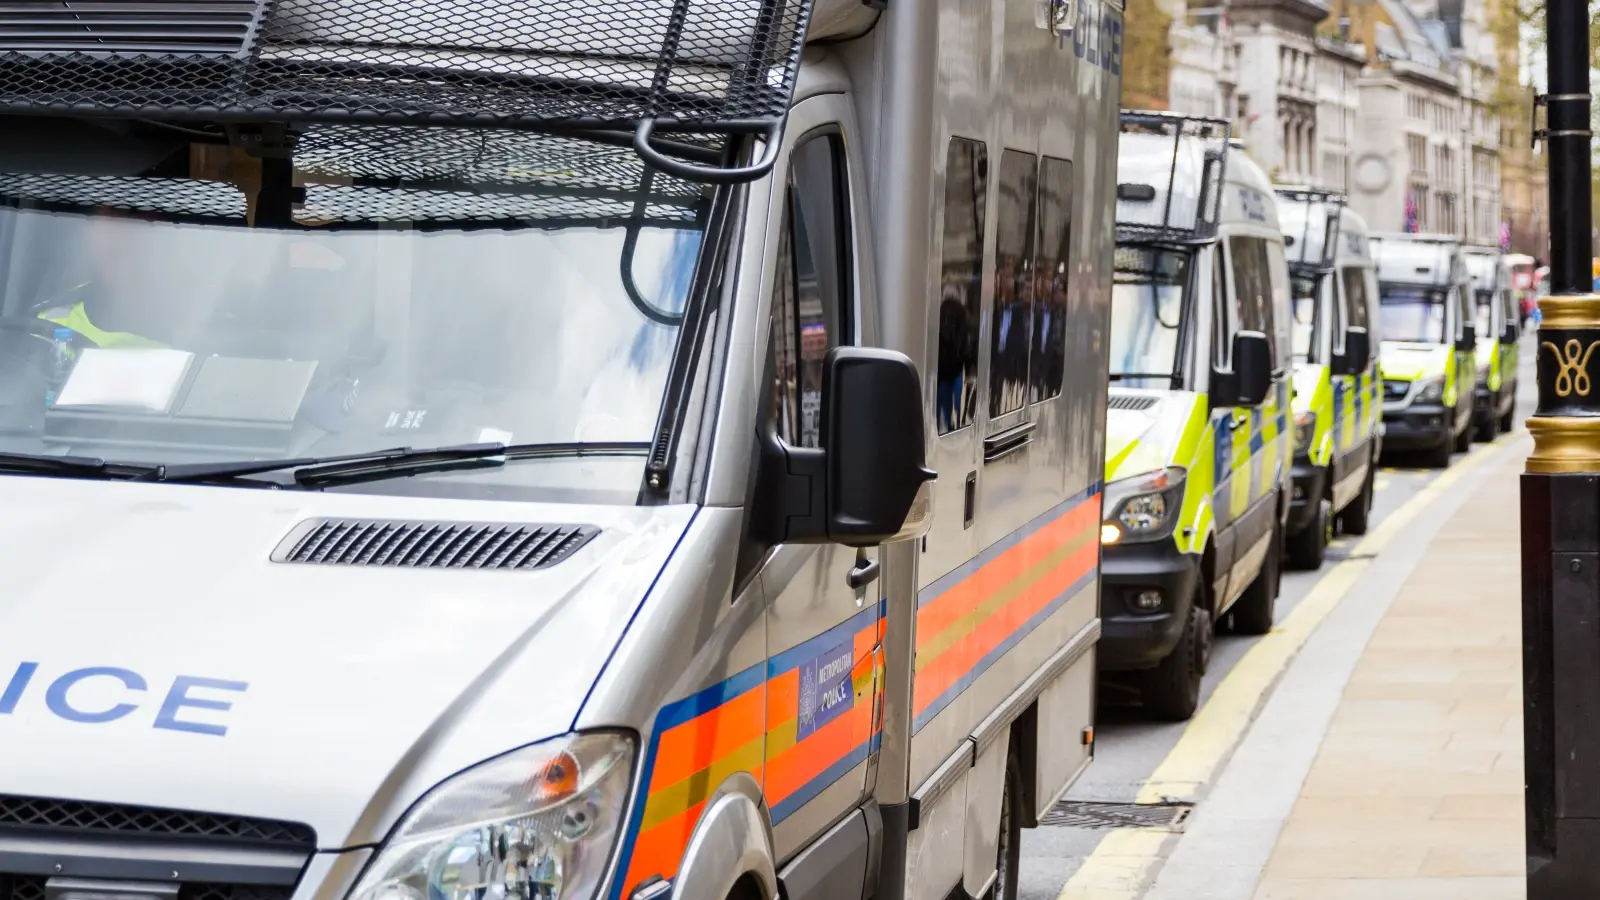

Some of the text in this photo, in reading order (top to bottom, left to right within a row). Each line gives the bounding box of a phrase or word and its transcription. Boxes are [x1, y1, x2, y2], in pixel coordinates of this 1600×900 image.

[818, 652, 852, 685] METROPOLITAN
[0, 661, 250, 737] ICE
[821, 680, 847, 712] POLICE
